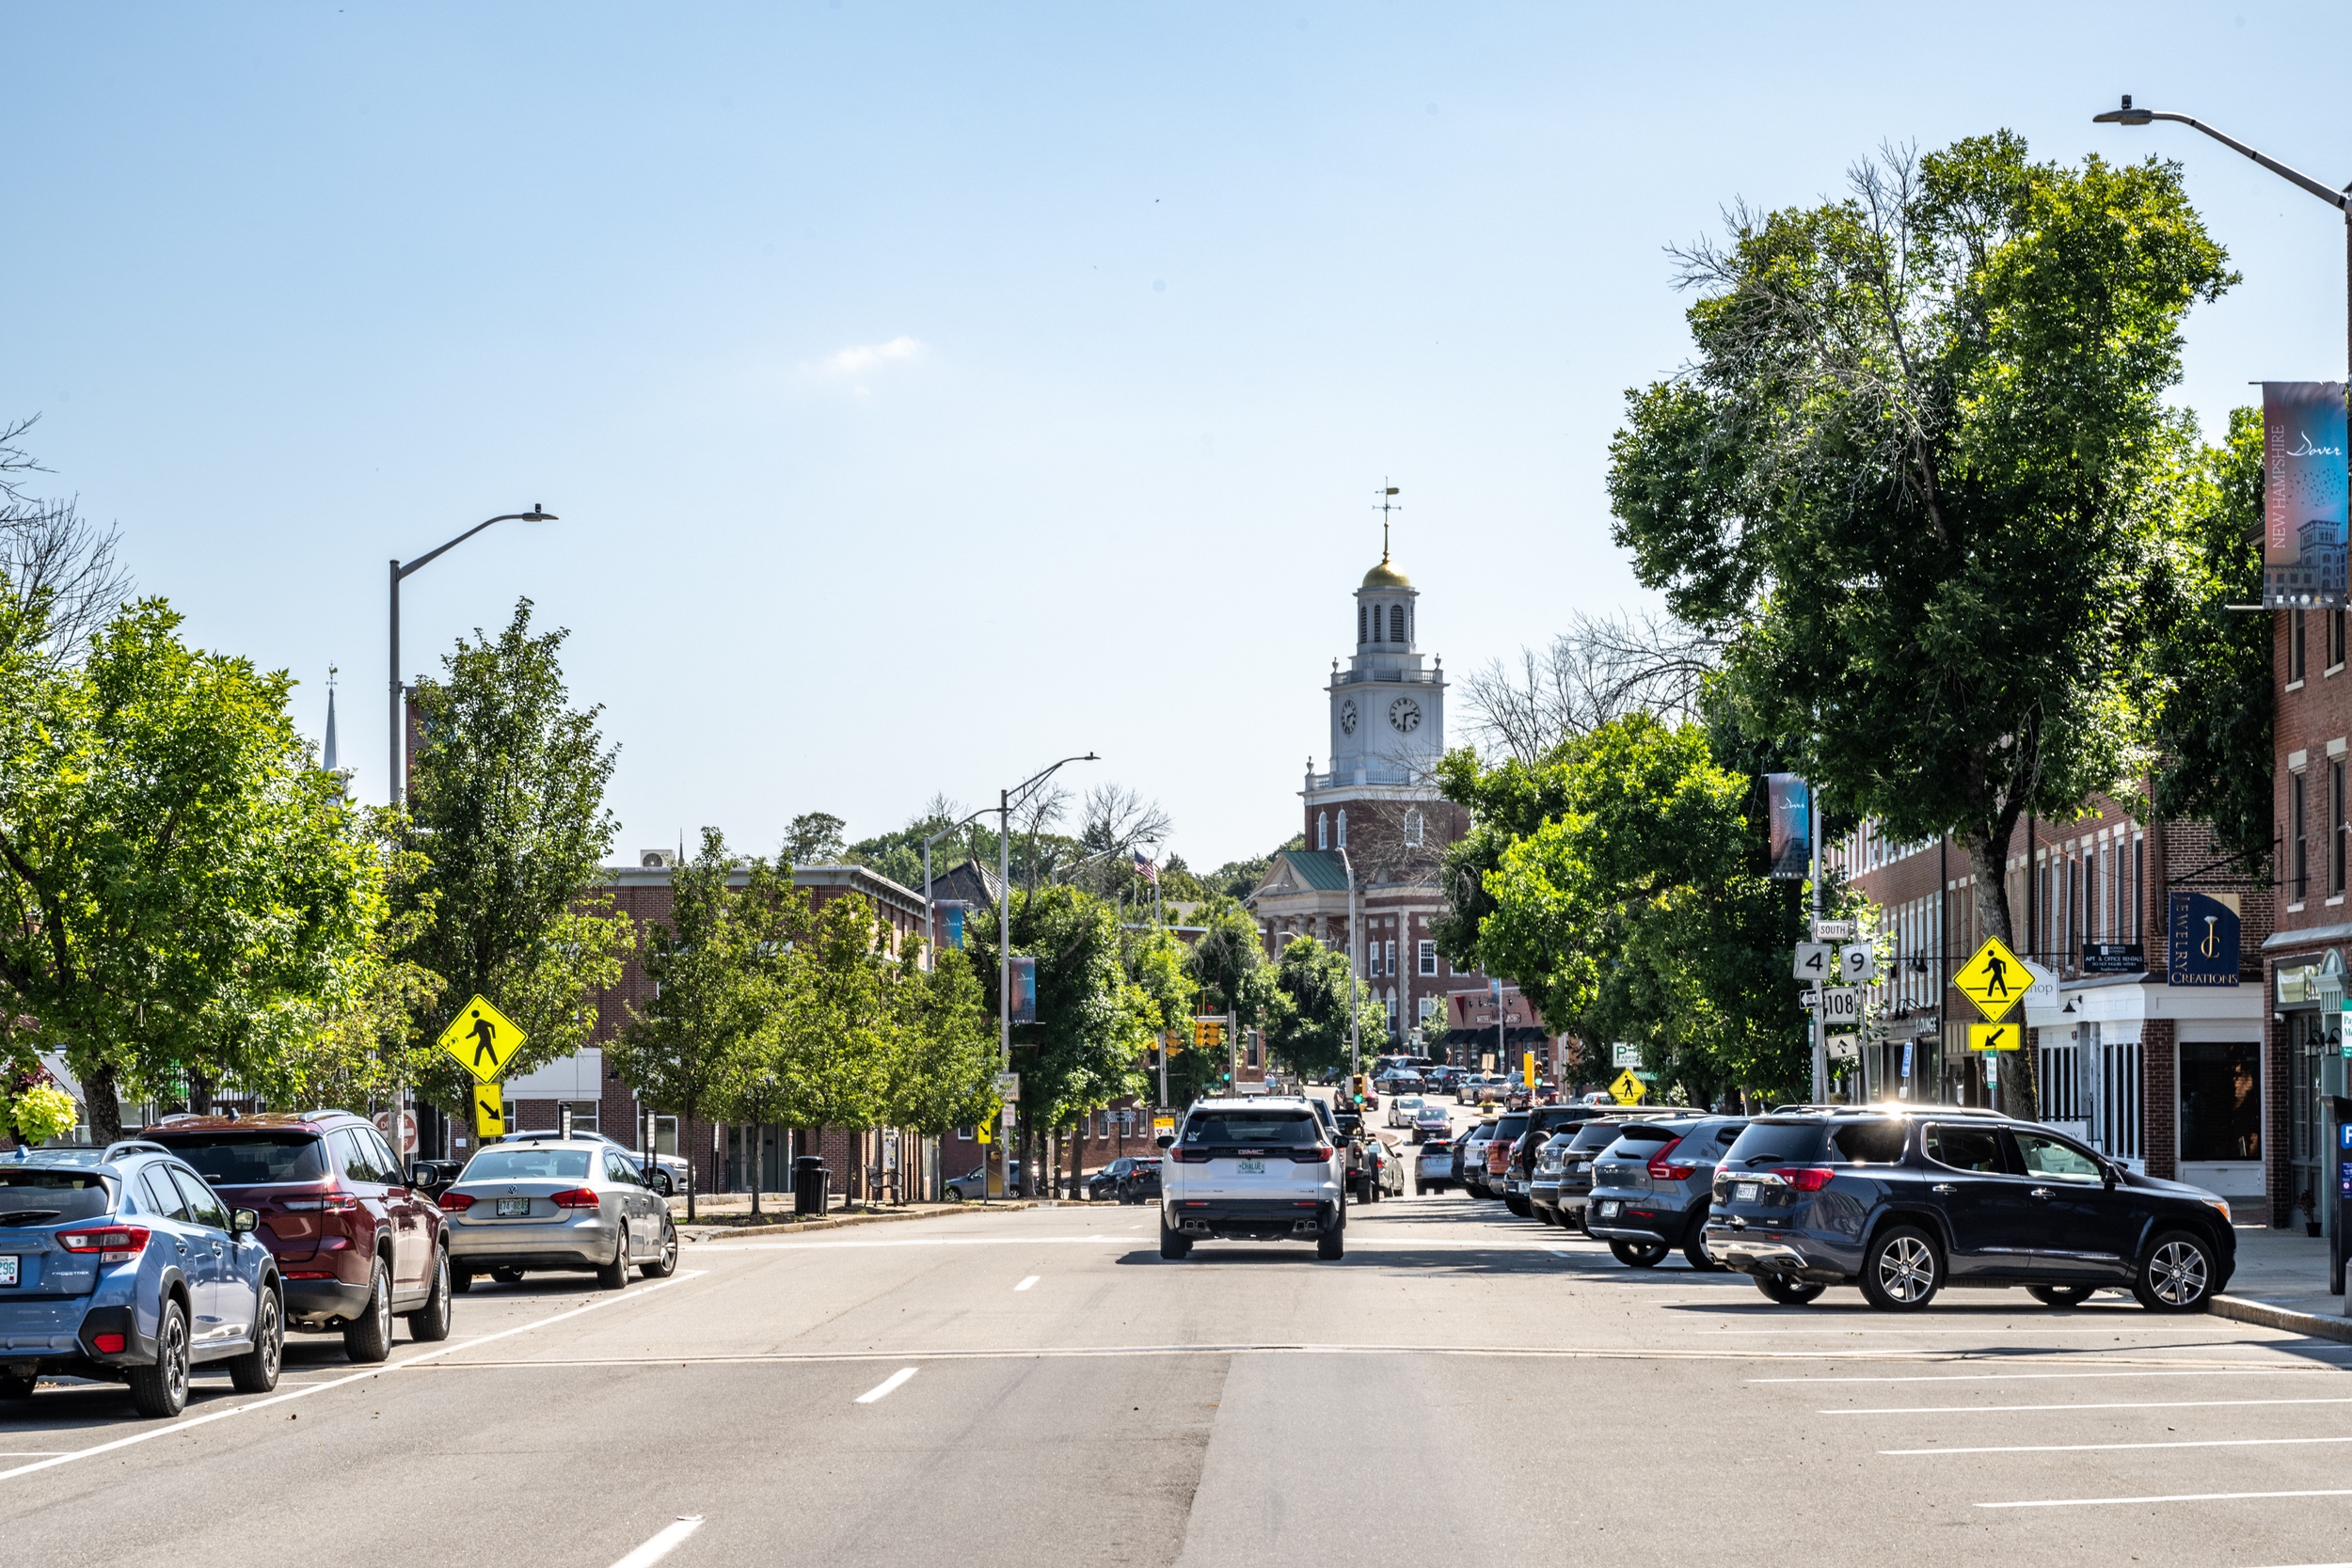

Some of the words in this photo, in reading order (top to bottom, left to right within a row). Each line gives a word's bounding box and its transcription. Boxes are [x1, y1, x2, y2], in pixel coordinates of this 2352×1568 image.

[2286, 430, 2343, 456] Dover
[2271, 425, 2285, 508] HAMPSHIRE
[2272, 511, 2286, 548] NEW
[1780, 797, 1805, 809] Dover
[1772, 794, 1780, 833] HAMPSHIRE
[1820, 925, 1846, 935] SOUTH
[2172, 895, 2190, 973] JEWELRY
[1805, 952, 1823, 972] 4
[1851, 953, 1865, 973] 9
[2171, 972, 2238, 984] CREATIONS
[1828, 994, 1853, 1015] 108
[2344, 1015, 2352, 1026] Pa
